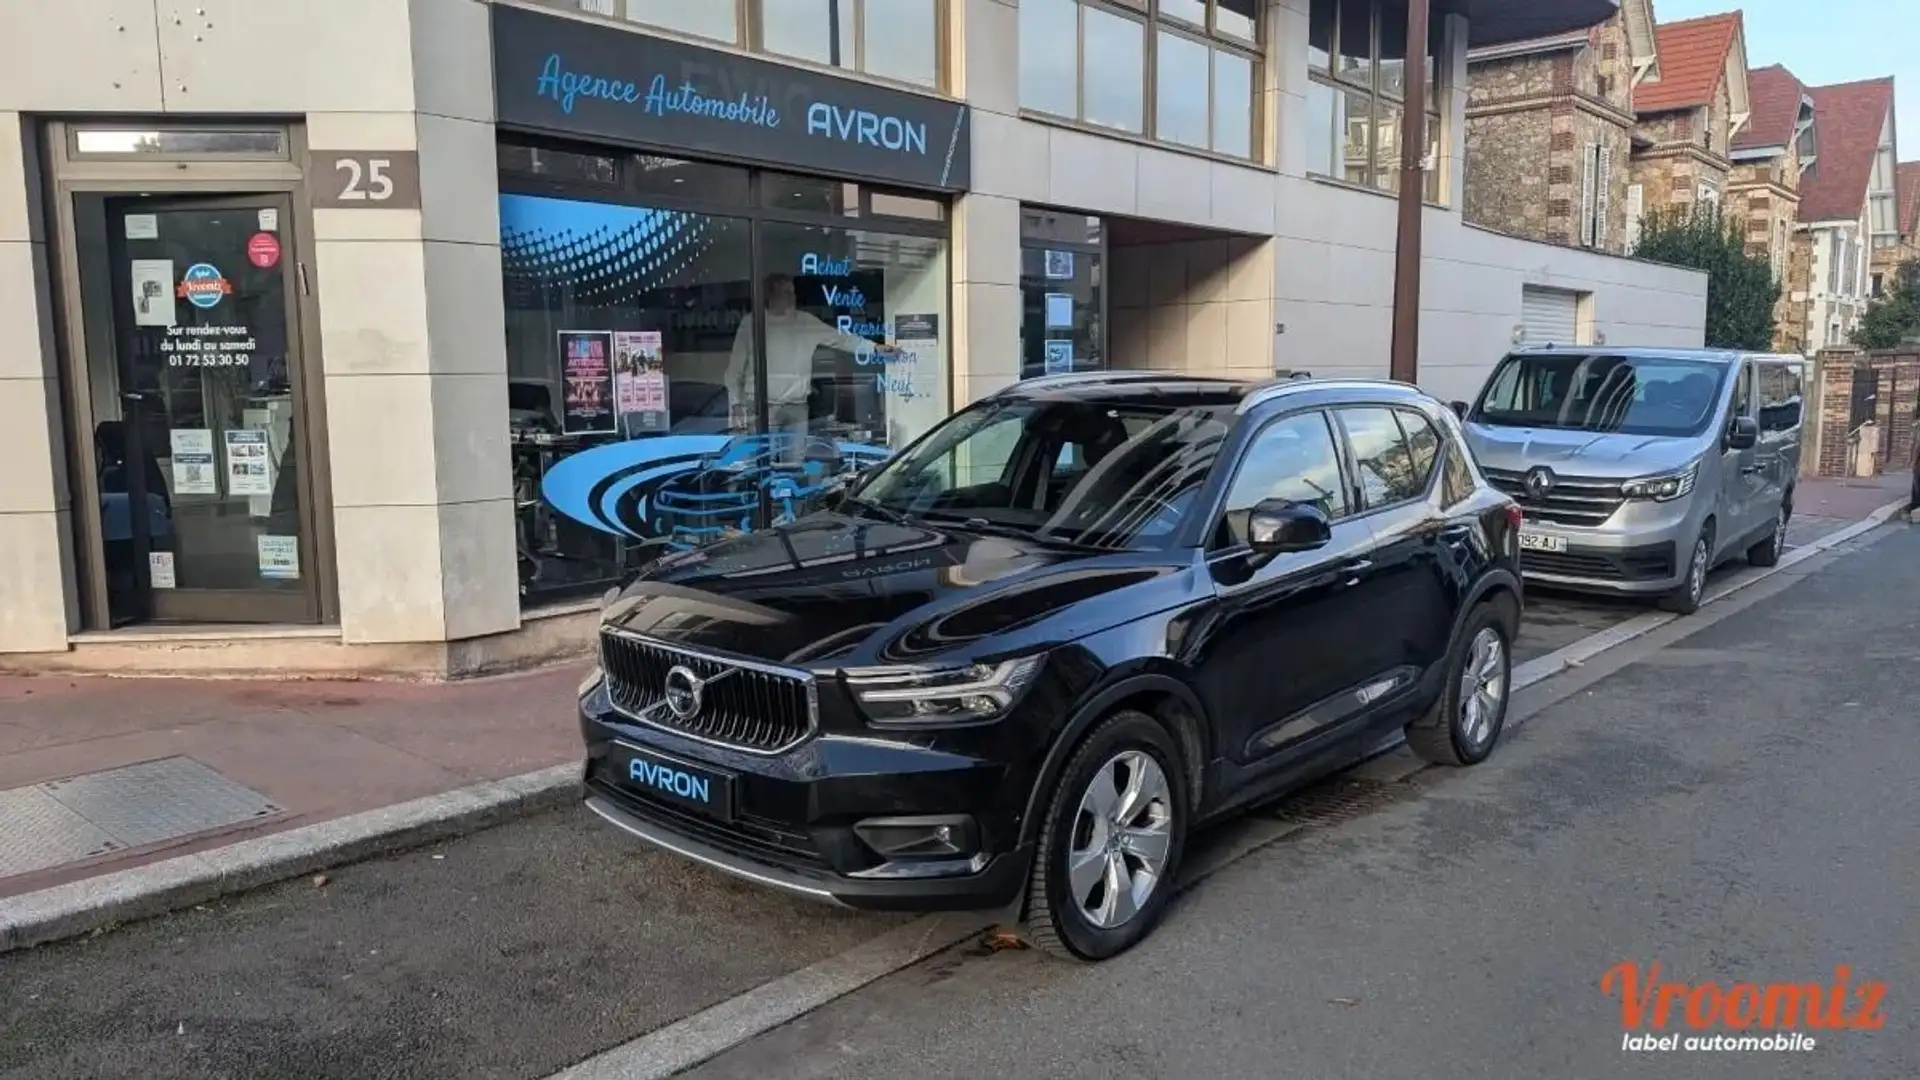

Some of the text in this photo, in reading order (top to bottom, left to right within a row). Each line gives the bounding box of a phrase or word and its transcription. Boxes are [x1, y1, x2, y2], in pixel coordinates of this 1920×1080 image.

[537, 52, 640, 115] Agence
[643, 73, 781, 130] Automobile
[807, 101, 927, 156] AVRON
[335, 158, 395, 202] 25
[800, 252, 852, 277] Achat
[821, 283, 866, 308] Vente
[166, 323, 247, 336] Sur rendez-vous
[160, 337, 256, 351] du lundi au samedi
[854, 347, 919, 366] Occion
[169, 353, 249, 367] 01 72 53 30 50
[629, 758, 710, 804] AVRON
